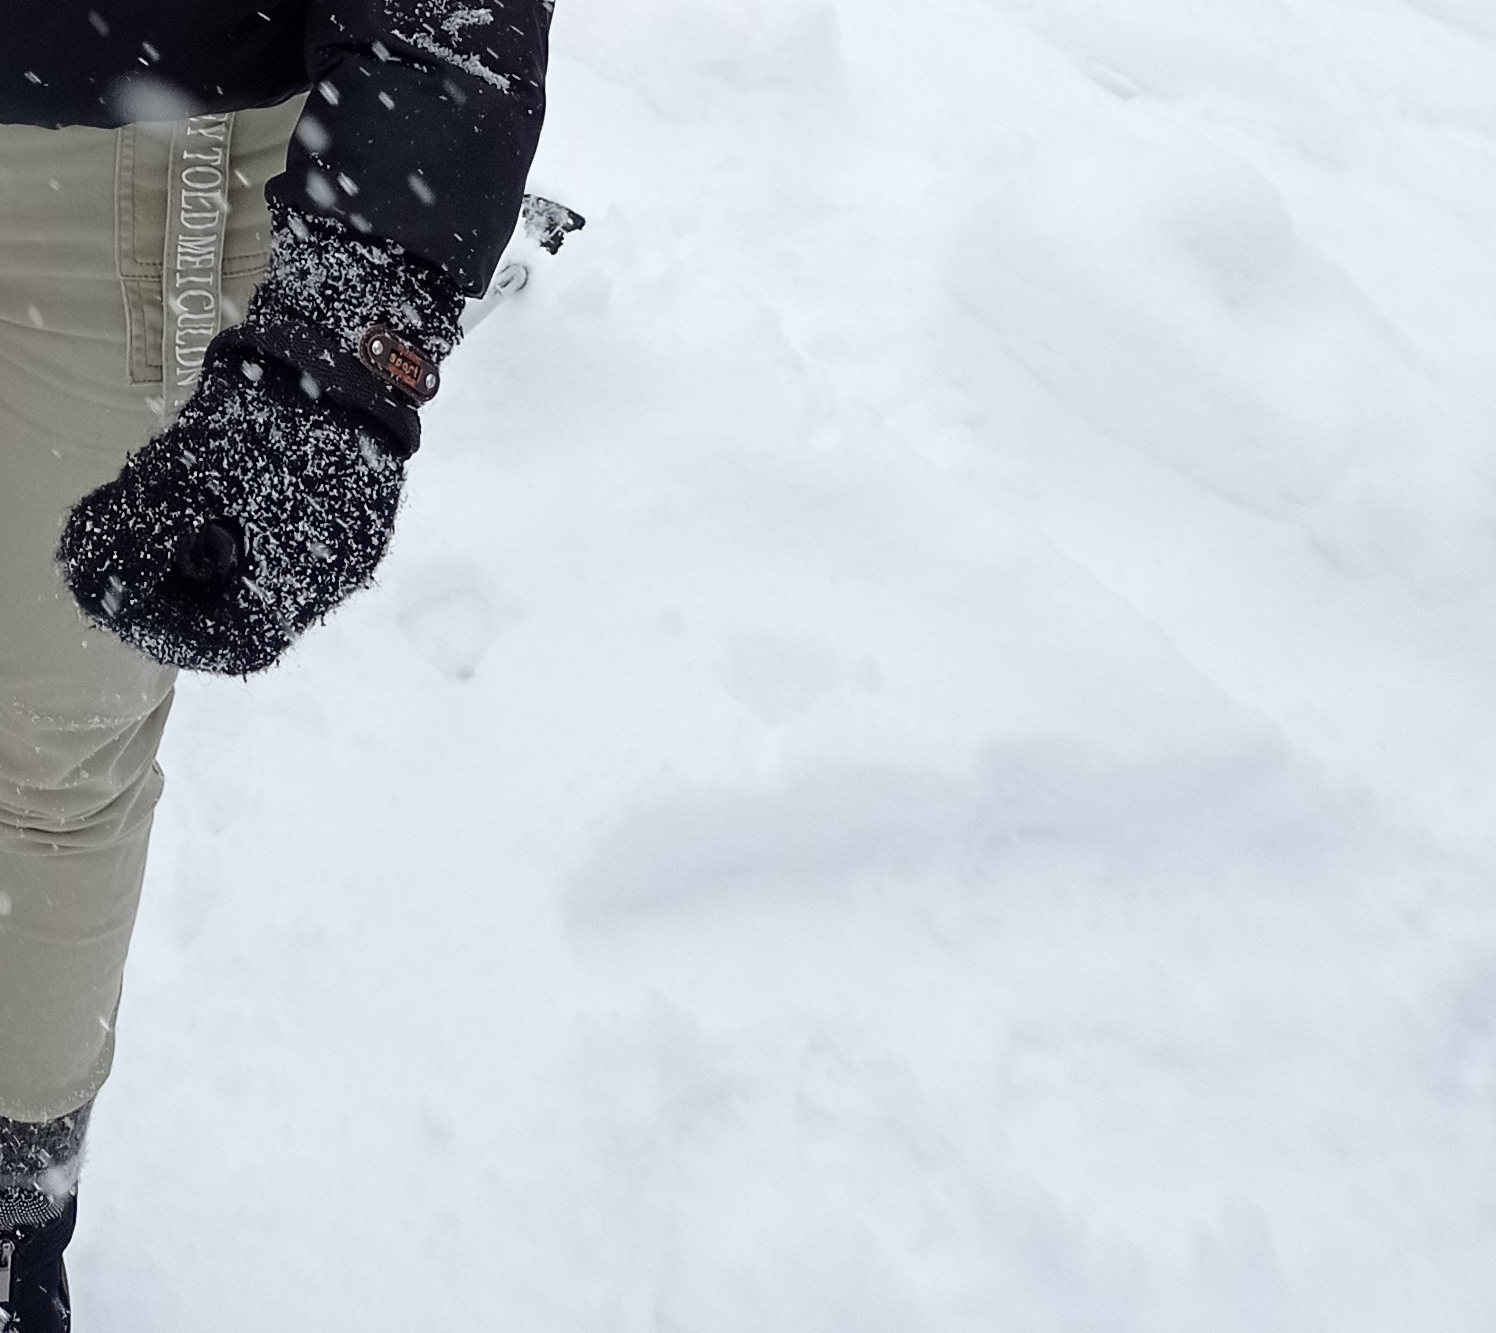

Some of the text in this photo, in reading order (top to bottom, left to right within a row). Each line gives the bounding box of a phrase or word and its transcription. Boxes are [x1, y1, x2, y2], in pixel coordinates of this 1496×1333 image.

[180, 147, 223, 229] TOLD
[176, 234, 218, 270] ME
[389, 352, 419, 378] sport
